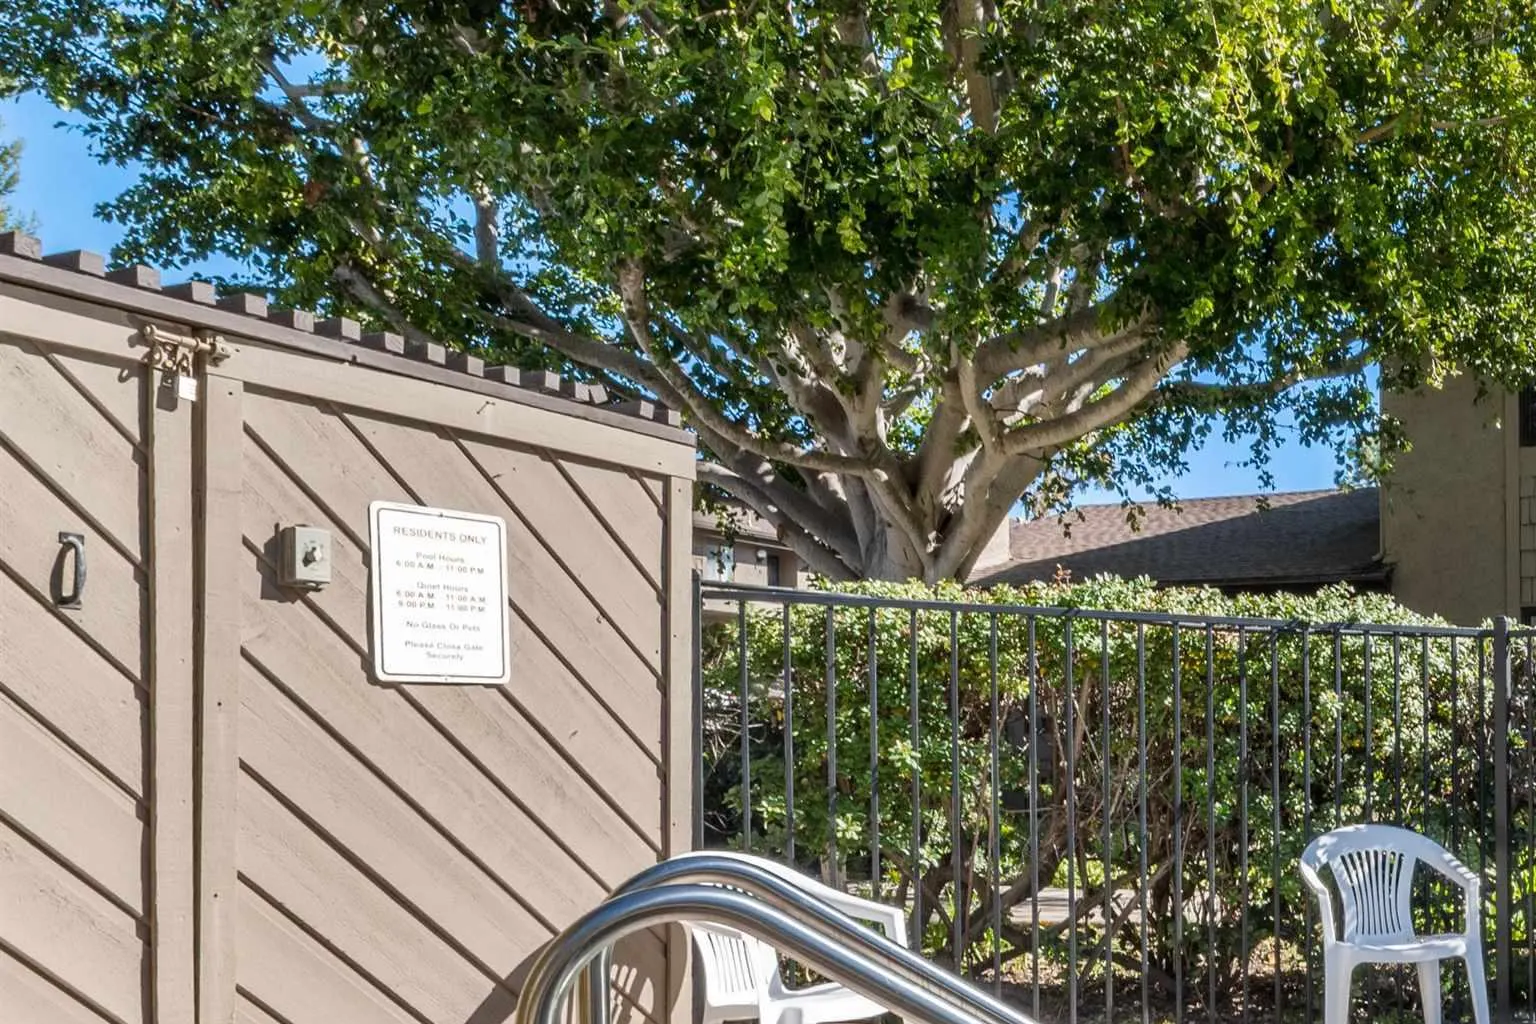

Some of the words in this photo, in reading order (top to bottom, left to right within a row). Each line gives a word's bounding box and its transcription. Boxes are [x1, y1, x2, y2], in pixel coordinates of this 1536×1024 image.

[393, 526, 457, 542] RESIDENTS
[459, 533, 487, 545] ONLY
[416, 551, 436, 561] Pool
[438, 554, 465, 563] Hours
[406, 620, 420, 628] No
[404, 640, 435, 649] Please
